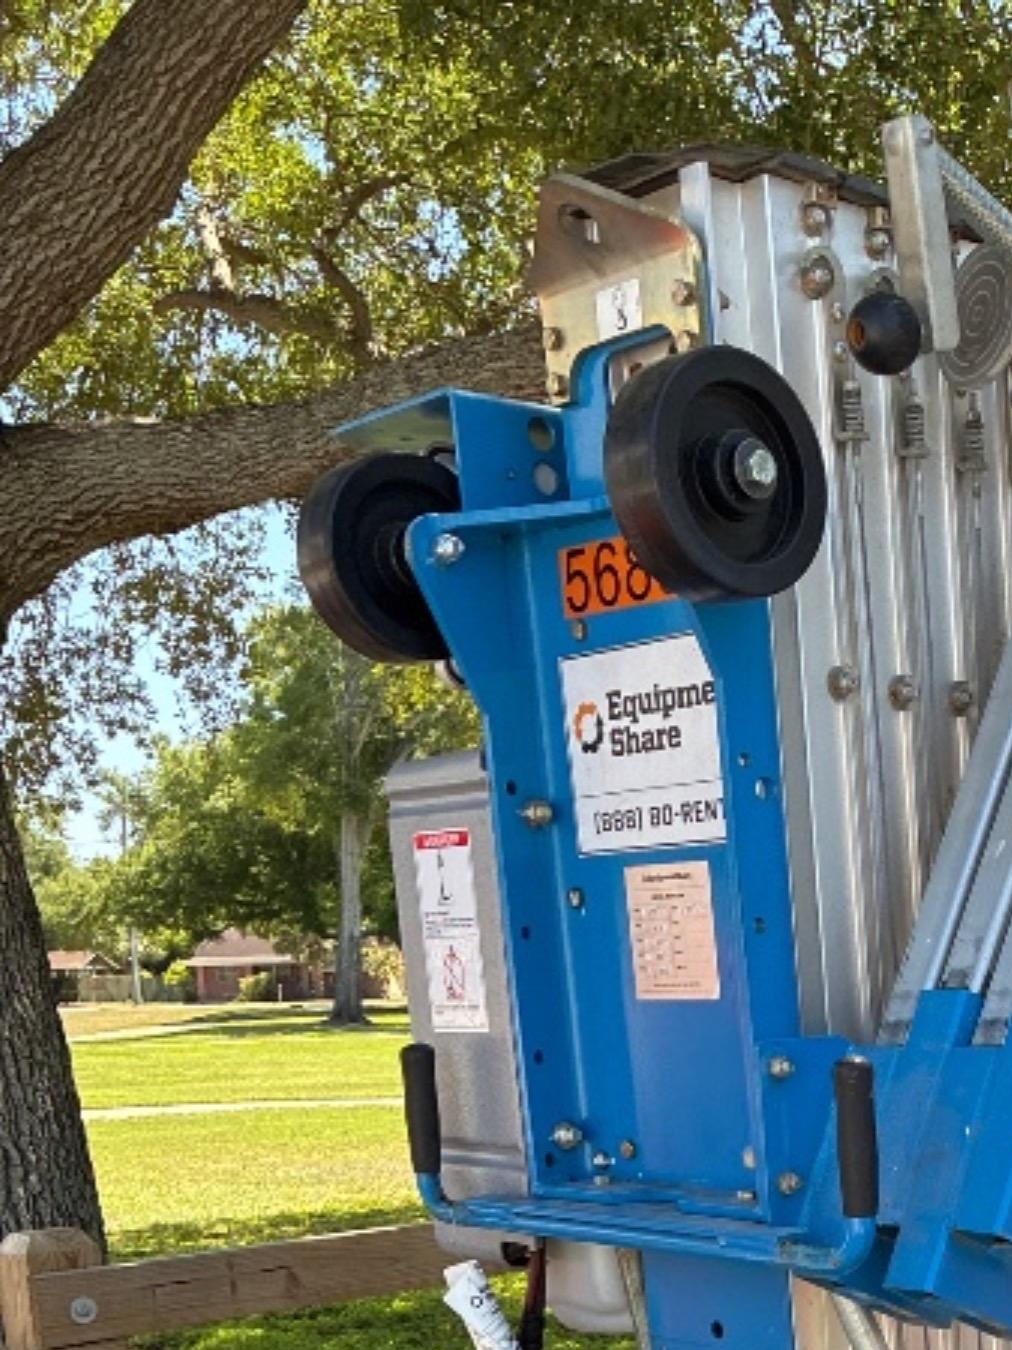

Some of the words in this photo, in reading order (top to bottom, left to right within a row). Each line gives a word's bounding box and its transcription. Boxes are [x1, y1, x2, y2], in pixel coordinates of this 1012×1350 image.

[566, 541, 670, 612] 568
[610, 725, 682, 757] Share
[594, 807, 643, 834] (888)
